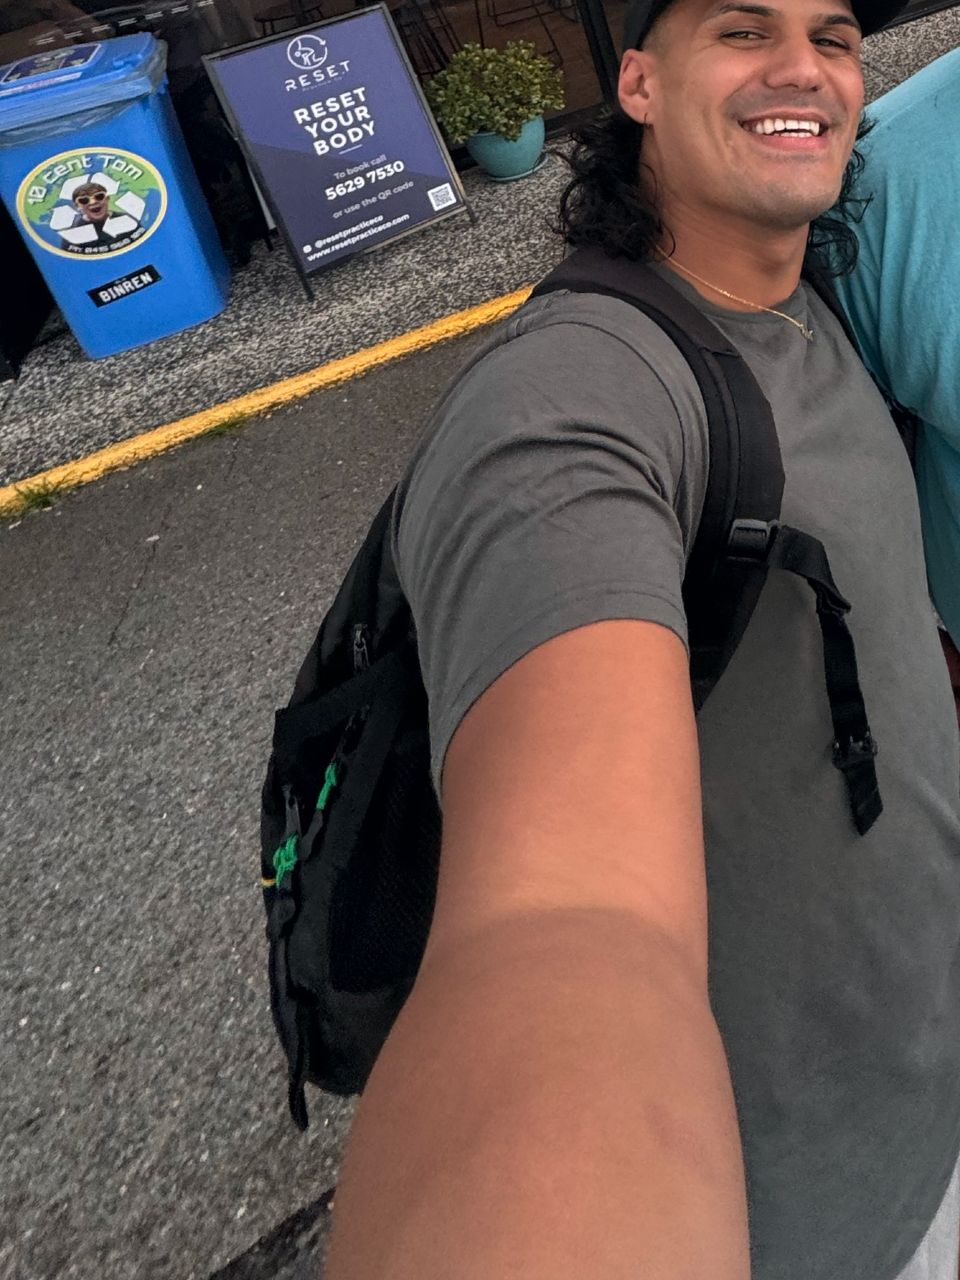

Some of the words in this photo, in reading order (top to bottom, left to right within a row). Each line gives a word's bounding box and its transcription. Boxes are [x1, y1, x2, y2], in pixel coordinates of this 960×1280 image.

[285, 60, 351, 92] RESET
[293, 87, 366, 124] RESET
[304, 105, 371, 138] YOUR
[313, 120, 375, 156] BODY
[97, 154, 142, 181] Tom
[325, 176, 366, 201] 5629
[366, 160, 405, 183] 7530
[333, 171, 346, 180] To
[346, 161, 370, 176] book
[370, 154, 387, 166] call
[344, 203, 361, 214] use
[361, 196, 378, 208] the
[377, 189, 393, 201] QR
[392, 180, 414, 195] code
[98, 272, 153, 303] BINREN
